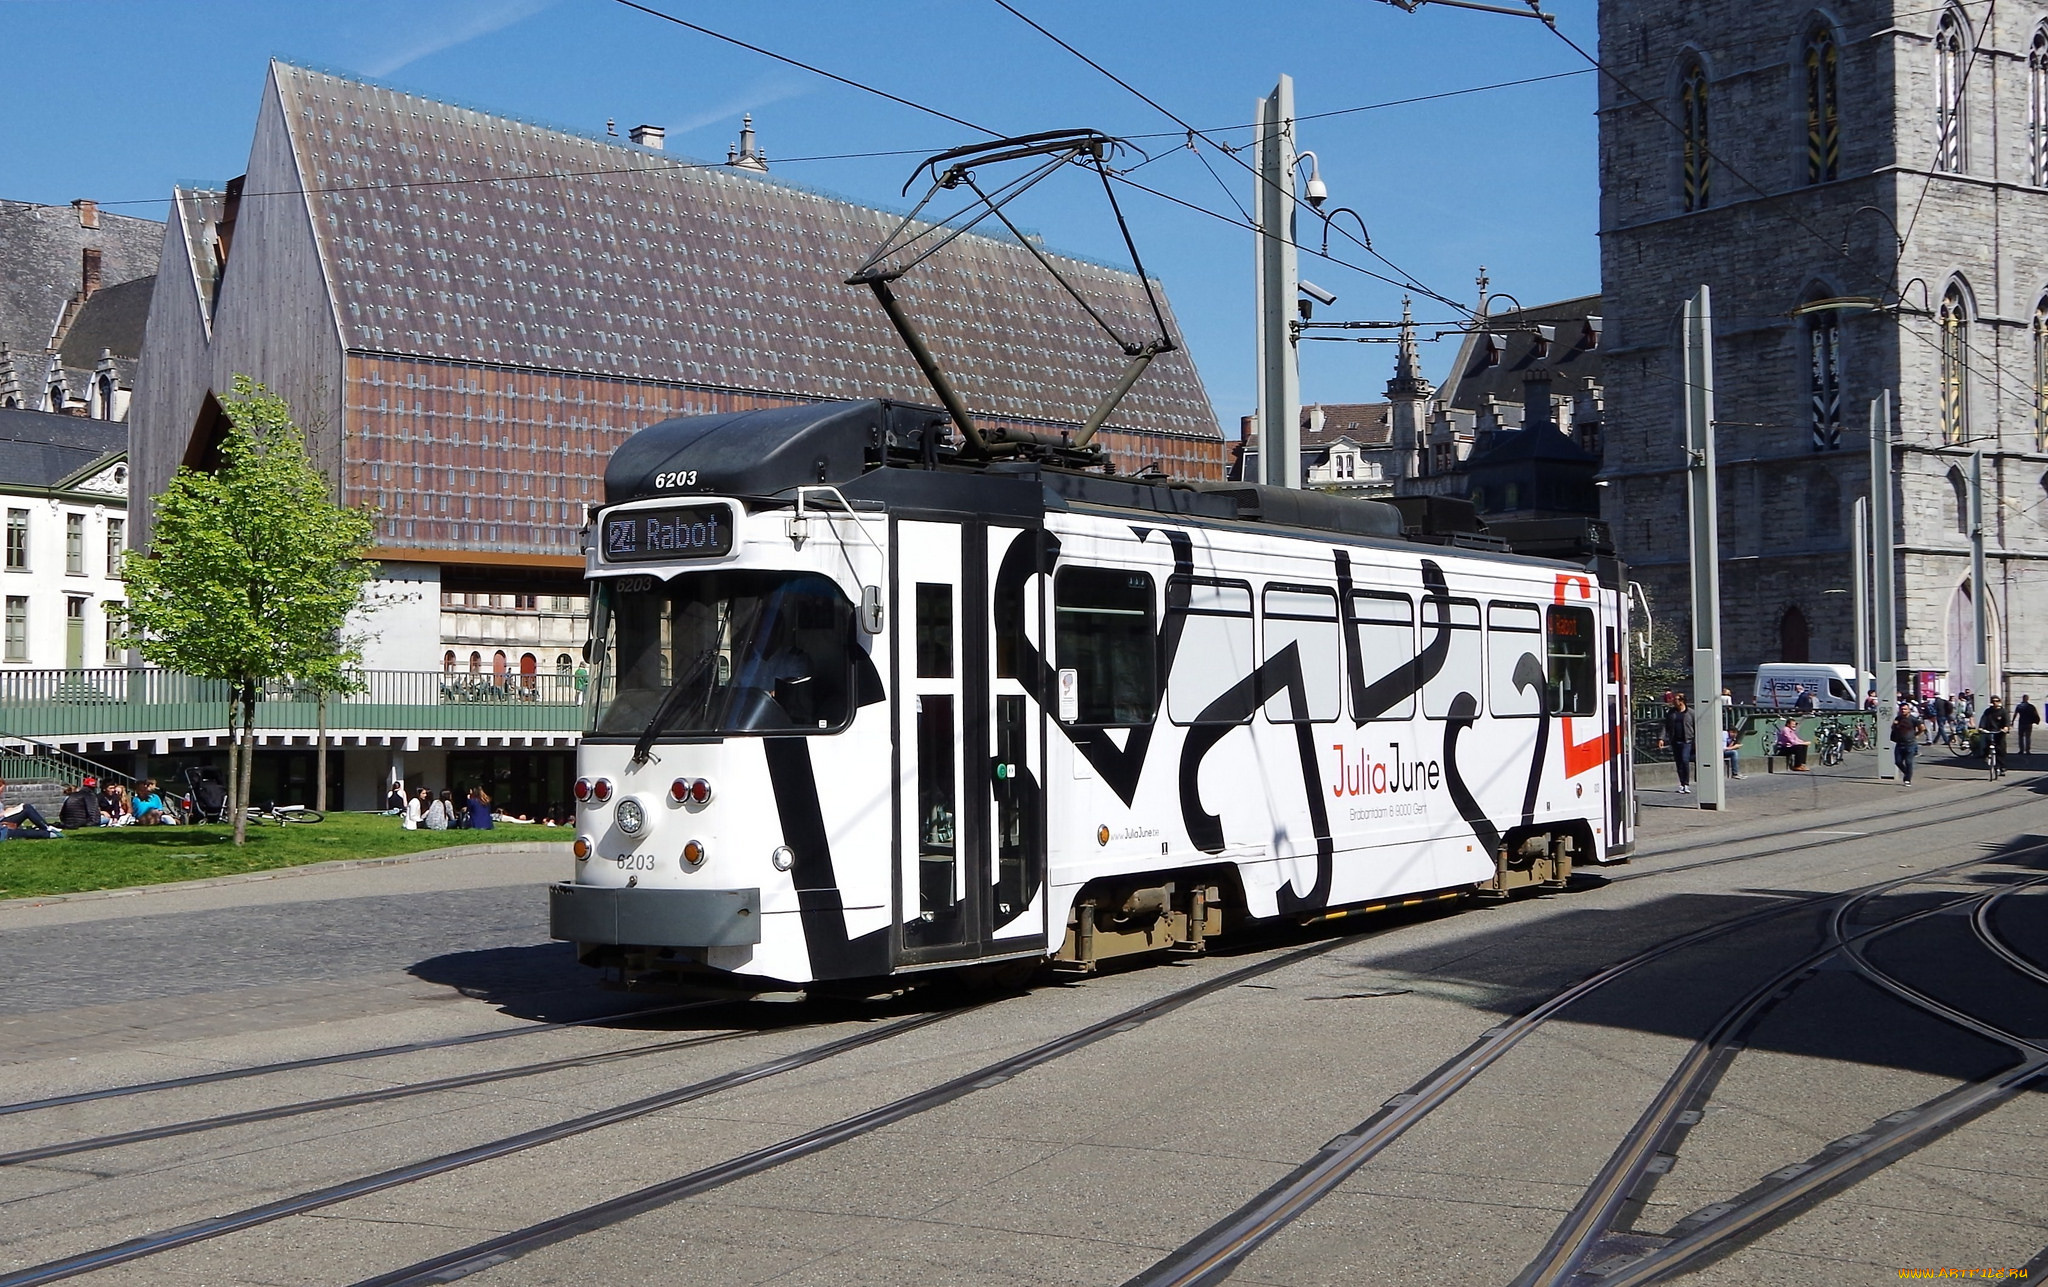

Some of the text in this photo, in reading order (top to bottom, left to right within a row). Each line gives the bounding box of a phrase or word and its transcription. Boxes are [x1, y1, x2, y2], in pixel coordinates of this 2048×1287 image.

[655, 470, 698, 488] 6203
[610, 514, 718, 552] 24 Rabot
[616, 578, 651, 592] 6203
[1772, 682, 1819, 692] VERSTETE
[1333, 743, 1439, 797] JuliaJune
[1396, 803, 1412, 817] 9000
[1413, 802, 1427, 815] Gent
[617, 853, 655, 871] 6203
